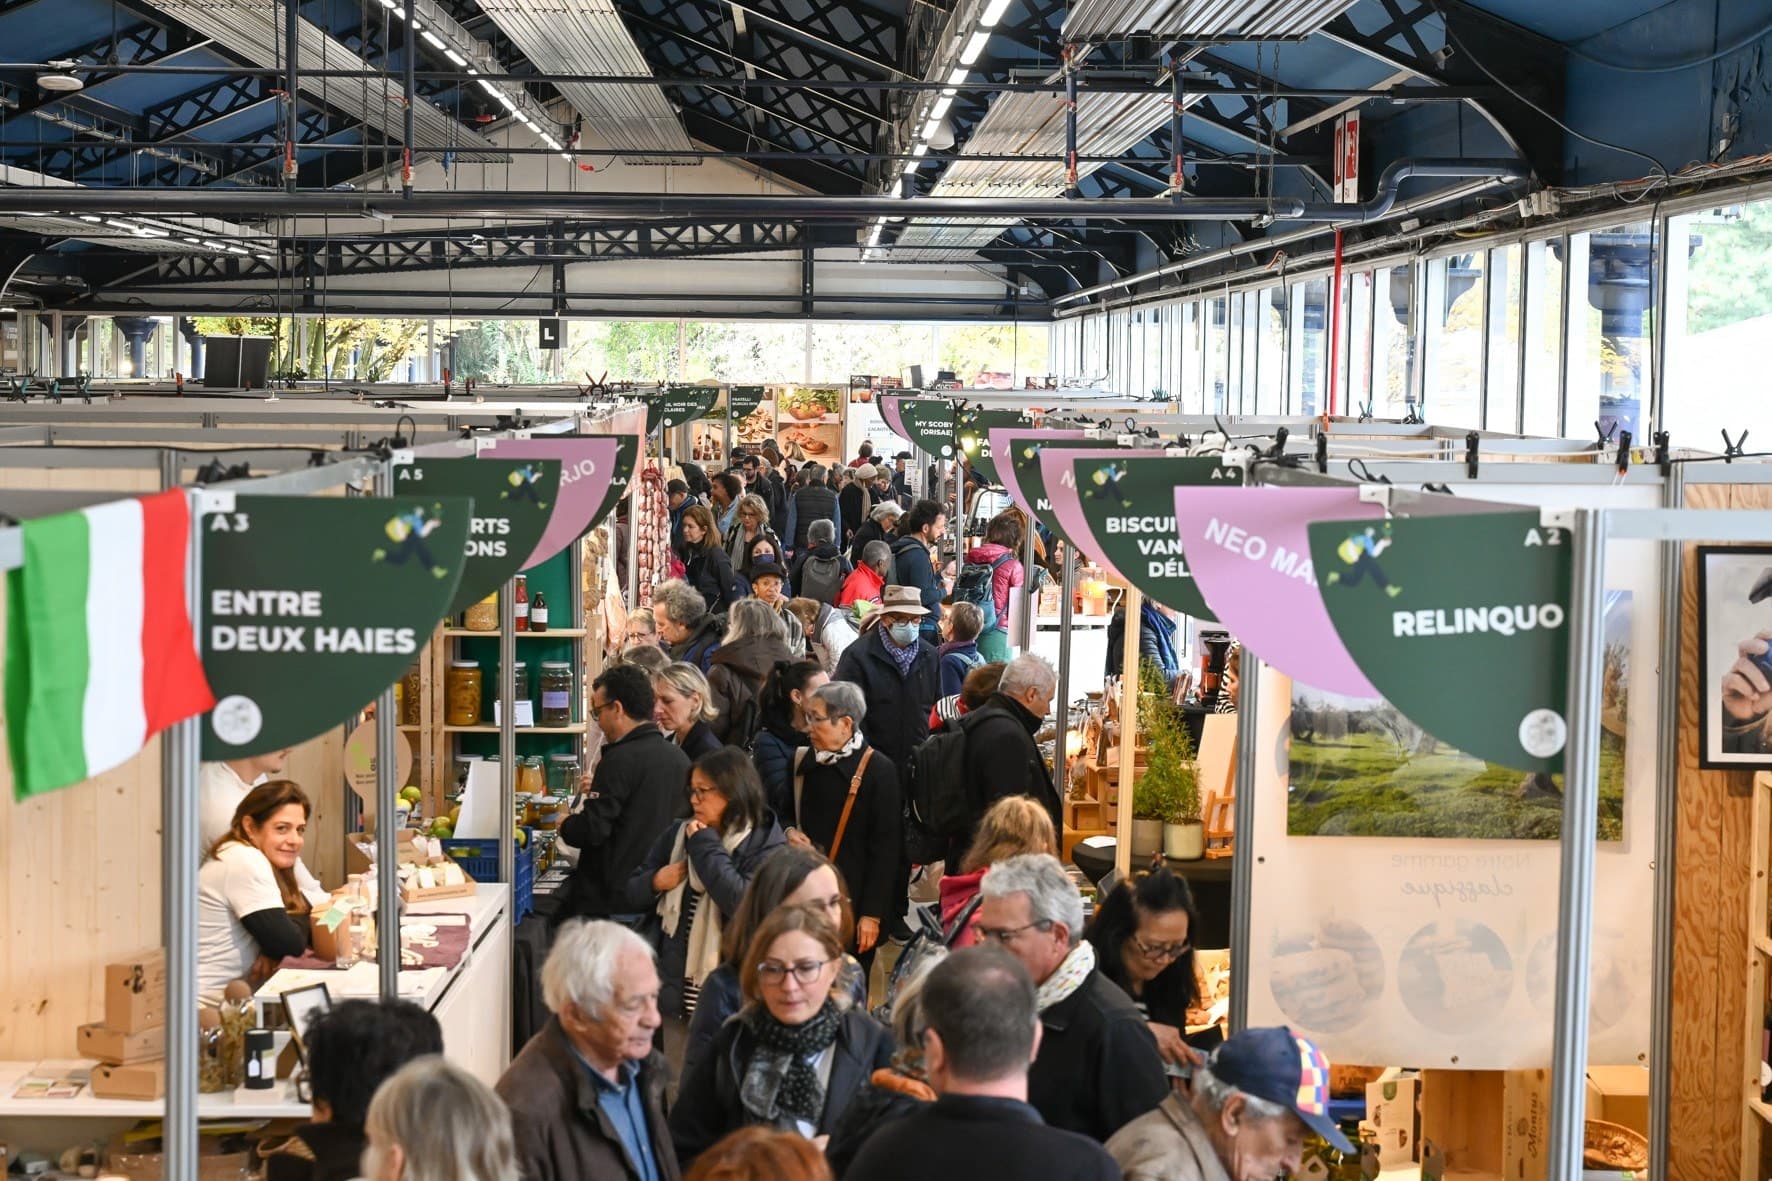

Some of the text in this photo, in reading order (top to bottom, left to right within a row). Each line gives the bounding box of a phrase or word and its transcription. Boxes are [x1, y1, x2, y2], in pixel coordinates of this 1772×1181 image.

[544, 327, 555, 341] L
[928, 420, 954, 428] SCOBY
[399, 469, 424, 481] A 5
[1210, 468, 1237, 480] A 4
[210, 514, 250, 533] A 3
[1137, 538, 1183, 556] VAN
[1523, 527, 1562, 548] A 2
[1204, 516, 1319, 588] NEO MA
[210, 589, 323, 617] ENTRE
[1392, 602, 1565, 638] RELINQUO
[210, 625, 418, 654] DEUX HAIES
